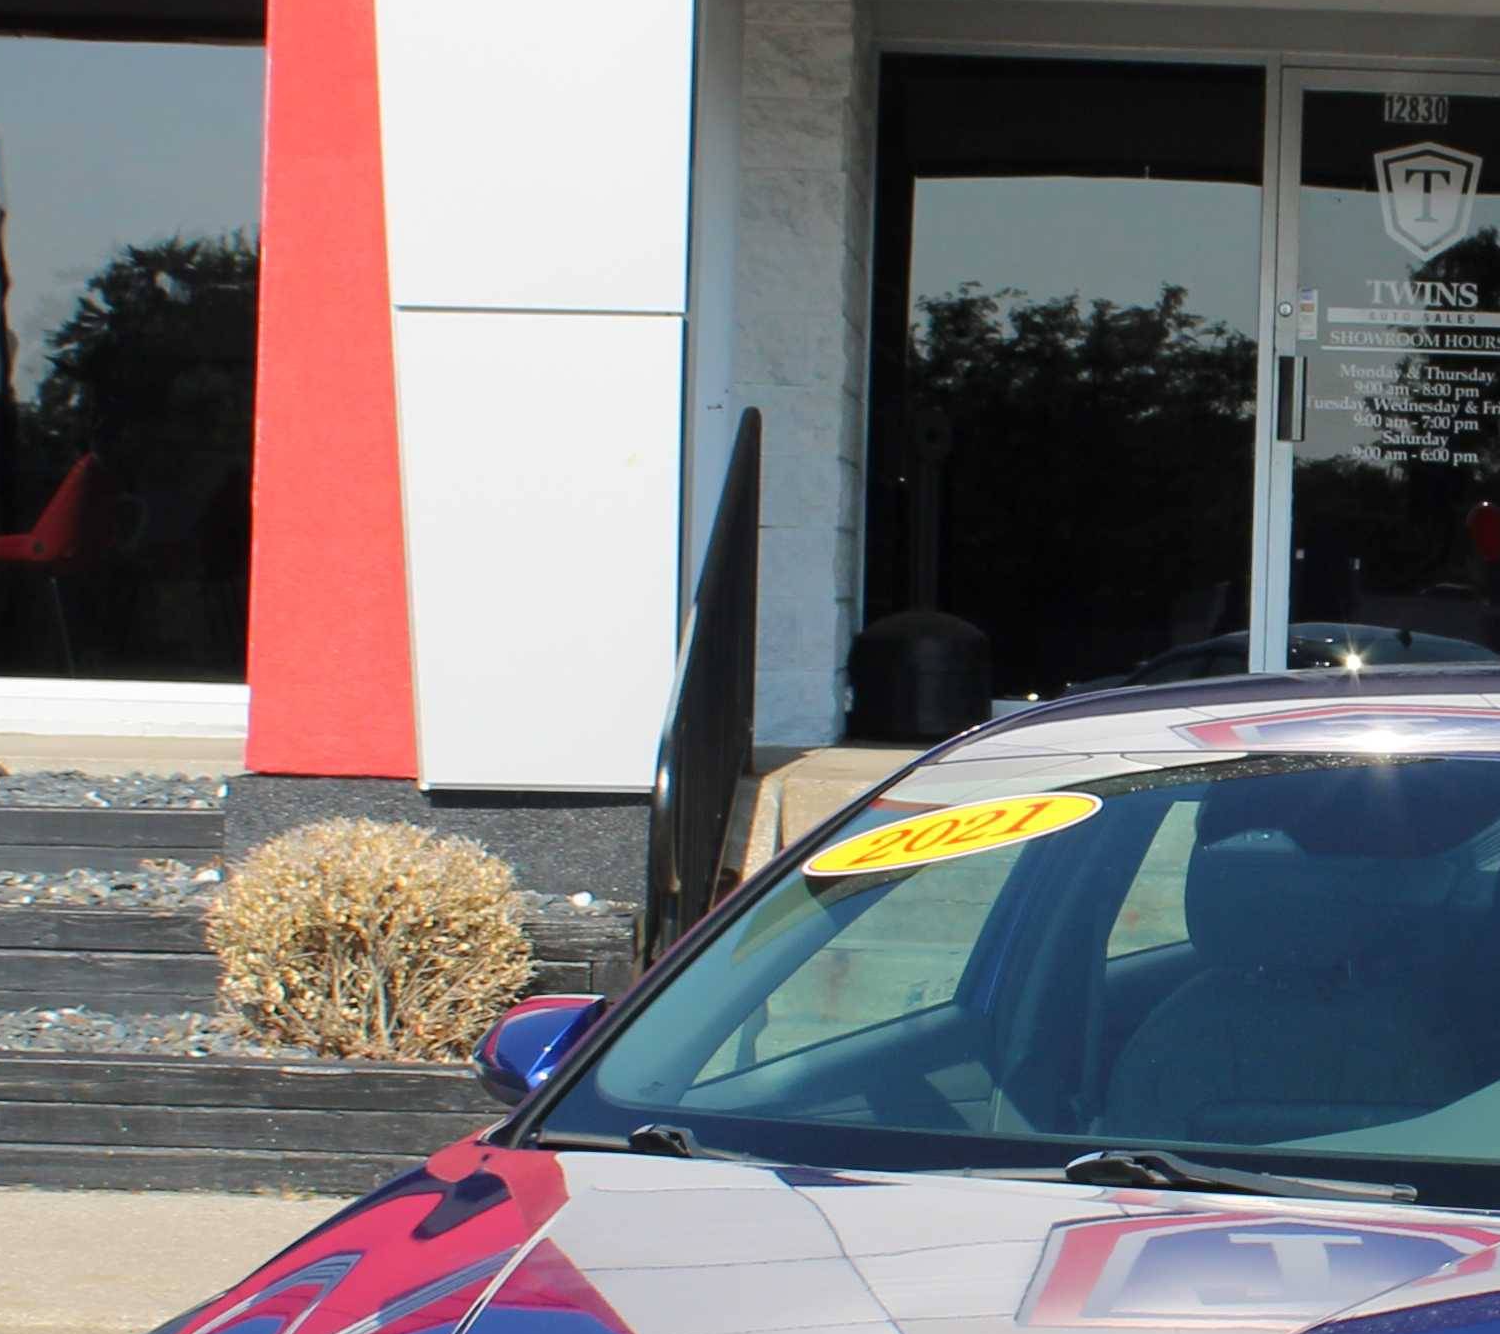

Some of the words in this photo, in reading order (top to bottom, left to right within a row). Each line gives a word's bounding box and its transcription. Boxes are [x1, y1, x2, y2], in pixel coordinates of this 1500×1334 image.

[1384, 96, 1447, 123] 12830
[1405, 169, 1451, 222] T
[1366, 279, 1479, 308] TWINS
[1424, 313, 1476, 324] SALES
[1330, 330, 1440, 348] SHOWROOM
[1339, 364, 1401, 382] Monday
[1406, 367, 1420, 380] &
[1425, 366, 1496, 385] Thursday
[1353, 381, 1383, 396] 9:00
[1386, 385, 1410, 396] am
[1422, 383, 1451, 397] 8:00
[1455, 386, 1480, 401] pm
[1373, 397, 1461, 416] Wednesday
[1465, 401, 1477, 415] &
[1353, 414, 1382, 429] 9:00
[1385, 417, 1409, 430] am
[1422, 415, 1450, 430] 7:00
[1453, 419, 1479, 434] pm
[1382, 430, 1449, 448] Saturday
[1352, 447, 1381, 461] 9:00
[1384, 450, 1408, 462] am
[1420, 448, 1449, 463] 6:00
[1452, 452, 1479, 467] pm
[847, 799, 1055, 867] 2021
